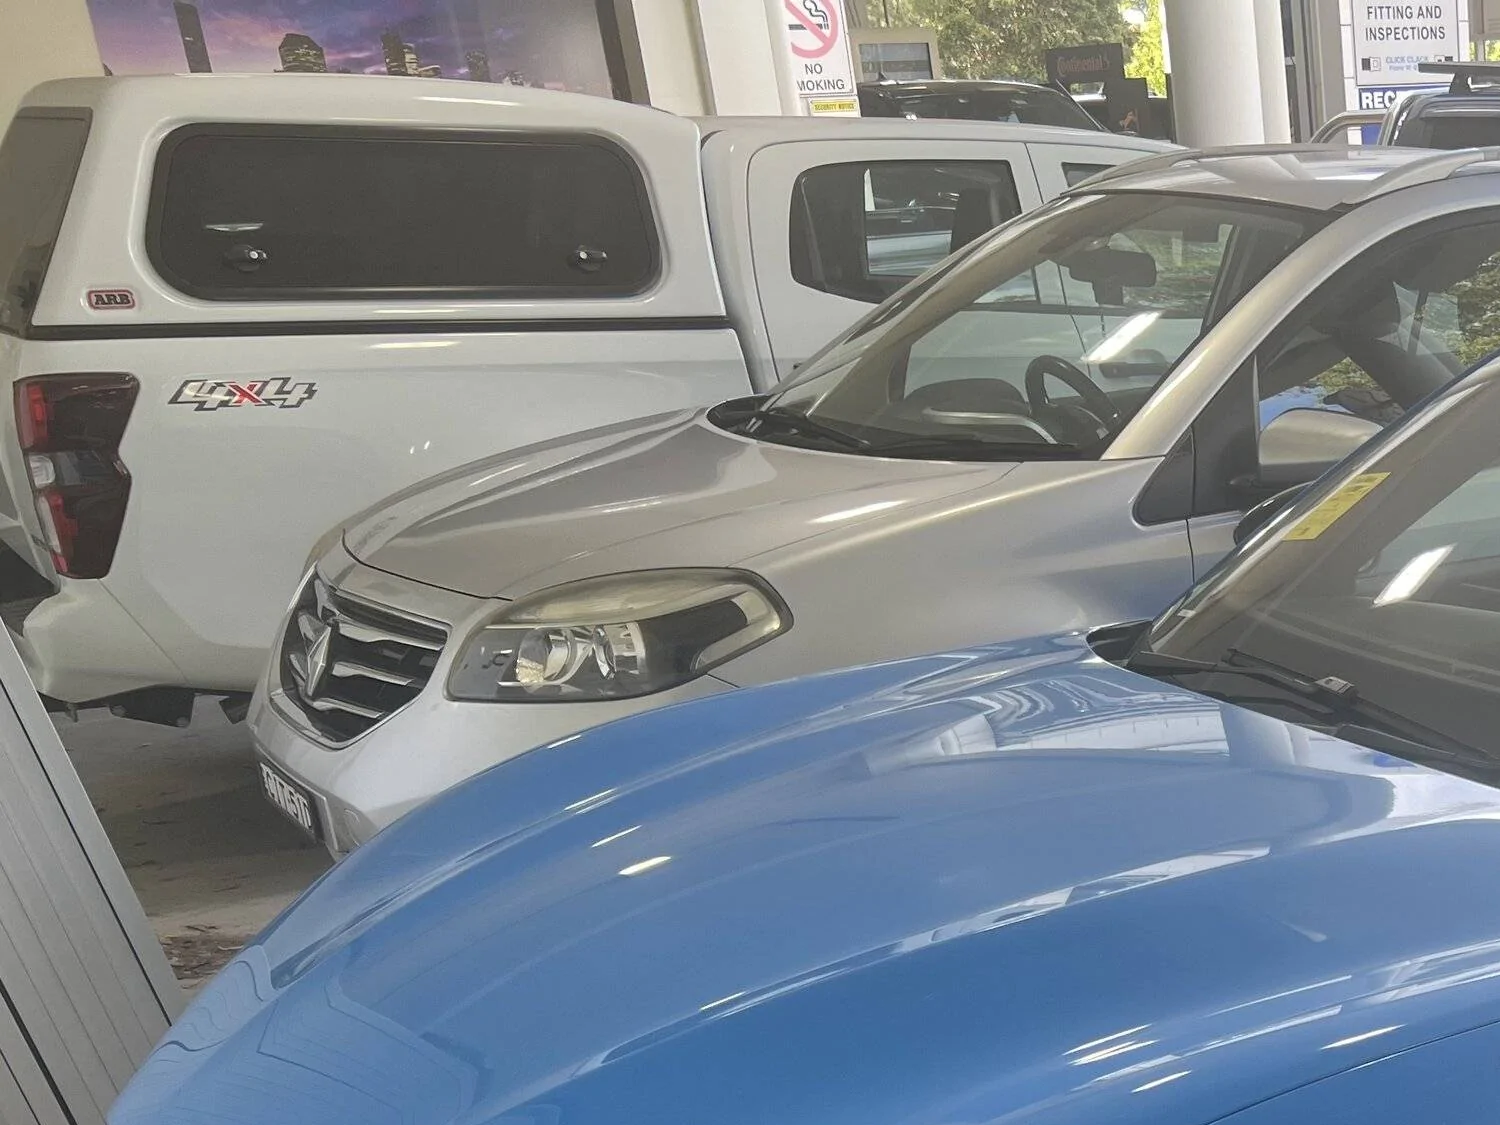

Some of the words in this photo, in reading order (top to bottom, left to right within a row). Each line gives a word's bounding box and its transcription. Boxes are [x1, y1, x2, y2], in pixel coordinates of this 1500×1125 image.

[1367, 6, 1413, 20] FITTING
[1417, 5, 1442, 19] AND
[1365, 26, 1446, 41] INSPECTIONS
[804, 63, 823, 75] NO
[797, 79, 845, 92] MOKING
[94, 293, 132, 306] ARB
